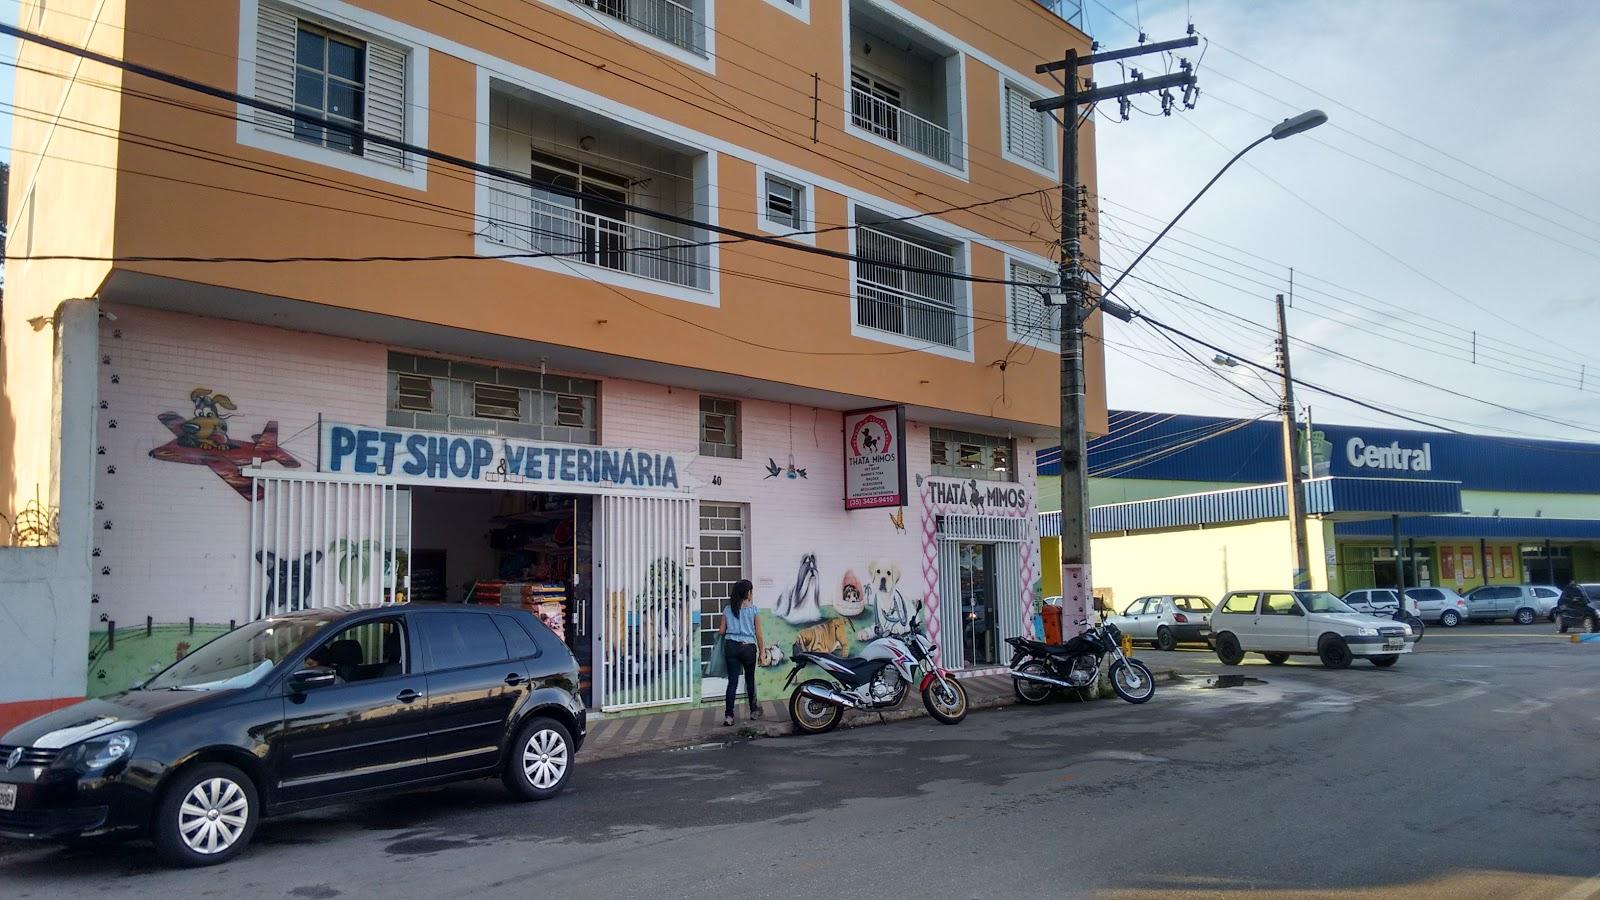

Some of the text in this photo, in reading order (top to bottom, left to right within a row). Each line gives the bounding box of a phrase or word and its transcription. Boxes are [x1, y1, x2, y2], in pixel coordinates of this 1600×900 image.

[330, 426, 402, 475] PET
[402, 434, 494, 480] SHOP
[504, 444, 679, 489] VETERINÁRIA
[1346, 437, 1432, 471] Central
[712, 475, 722, 486] 40
[928, 480, 1026, 508] THATÁ MIMOS
